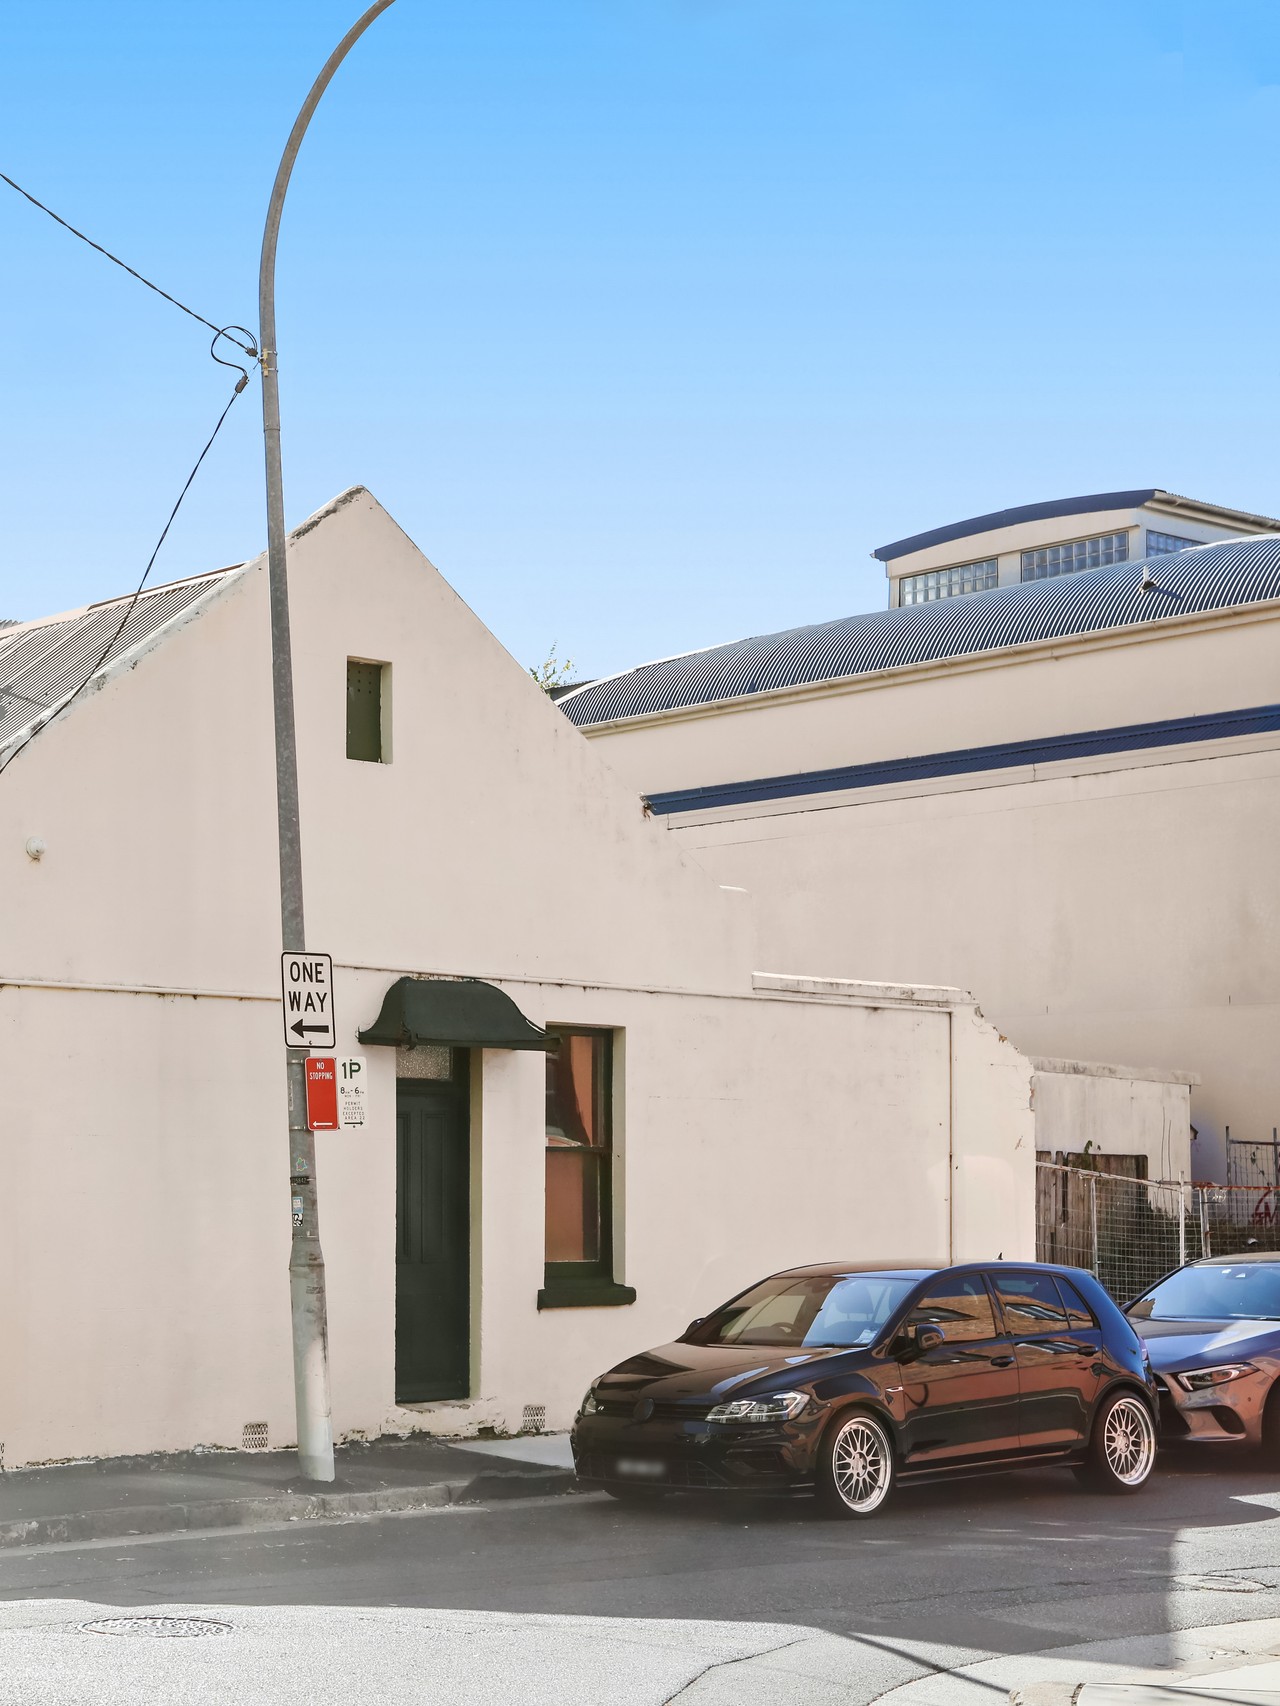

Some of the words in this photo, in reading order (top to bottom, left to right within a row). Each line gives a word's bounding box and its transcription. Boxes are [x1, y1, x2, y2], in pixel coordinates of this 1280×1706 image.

[290, 961, 325, 983] ONE
[288, 991, 327, 1012] WAY
[341, 1062, 361, 1079] 1P
